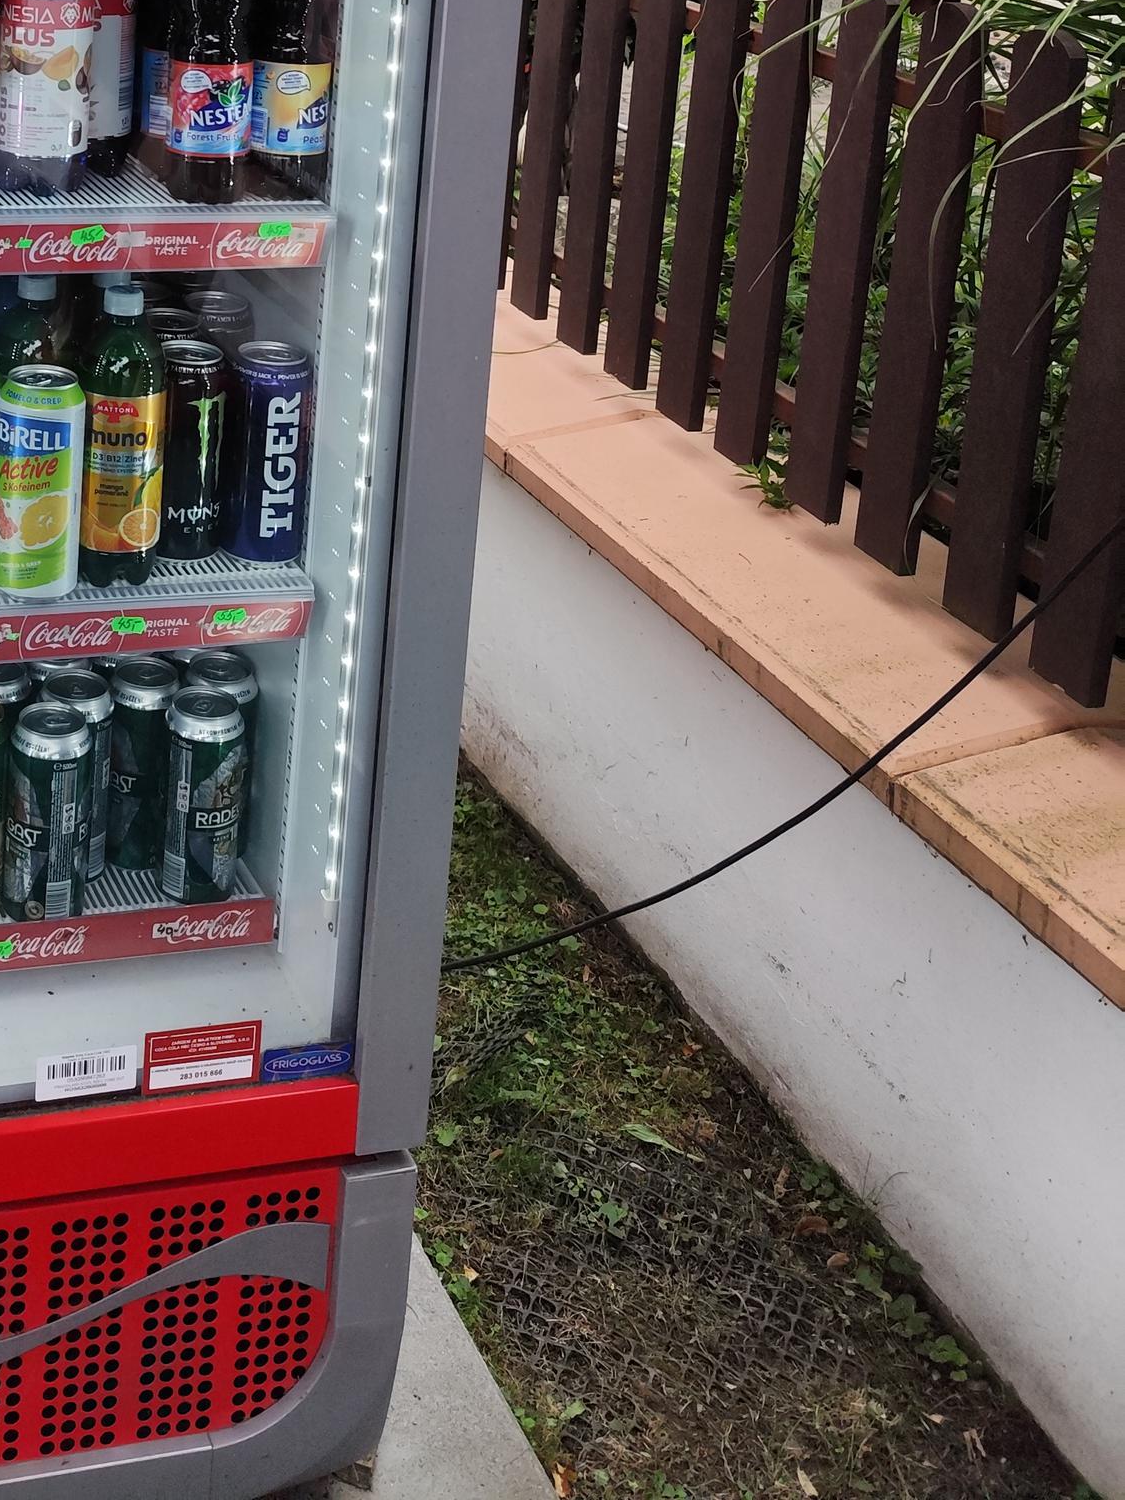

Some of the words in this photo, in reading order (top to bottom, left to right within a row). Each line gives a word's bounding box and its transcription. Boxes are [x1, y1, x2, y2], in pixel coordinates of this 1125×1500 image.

[3, 4, 55, 26] NESIA
[2, 27, 55, 48] PLUS
[298, 102, 328, 126] NEST
[186, 131, 214, 142] Forest
[154, 246, 189, 257] TASTE
[5, 388, 32, 403] POMELO
[41, 396, 63, 405] GREP
[96, 404, 134, 414] MATTONI
[91, 430, 148, 447] muno
[92, 452, 104, 461] D3
[106, 453, 121, 462] B12
[259, 391, 302, 539] TIGER
[0, 456, 59, 480] Active
[145, 618, 191, 628] RIGINAL
[25, 618, 115, 650] Coca-Cola
[147, 627, 179, 638] TASTE
[272, 1053, 342, 1070] FRIGOGLASS
[180, 1073, 193, 1081] 283
